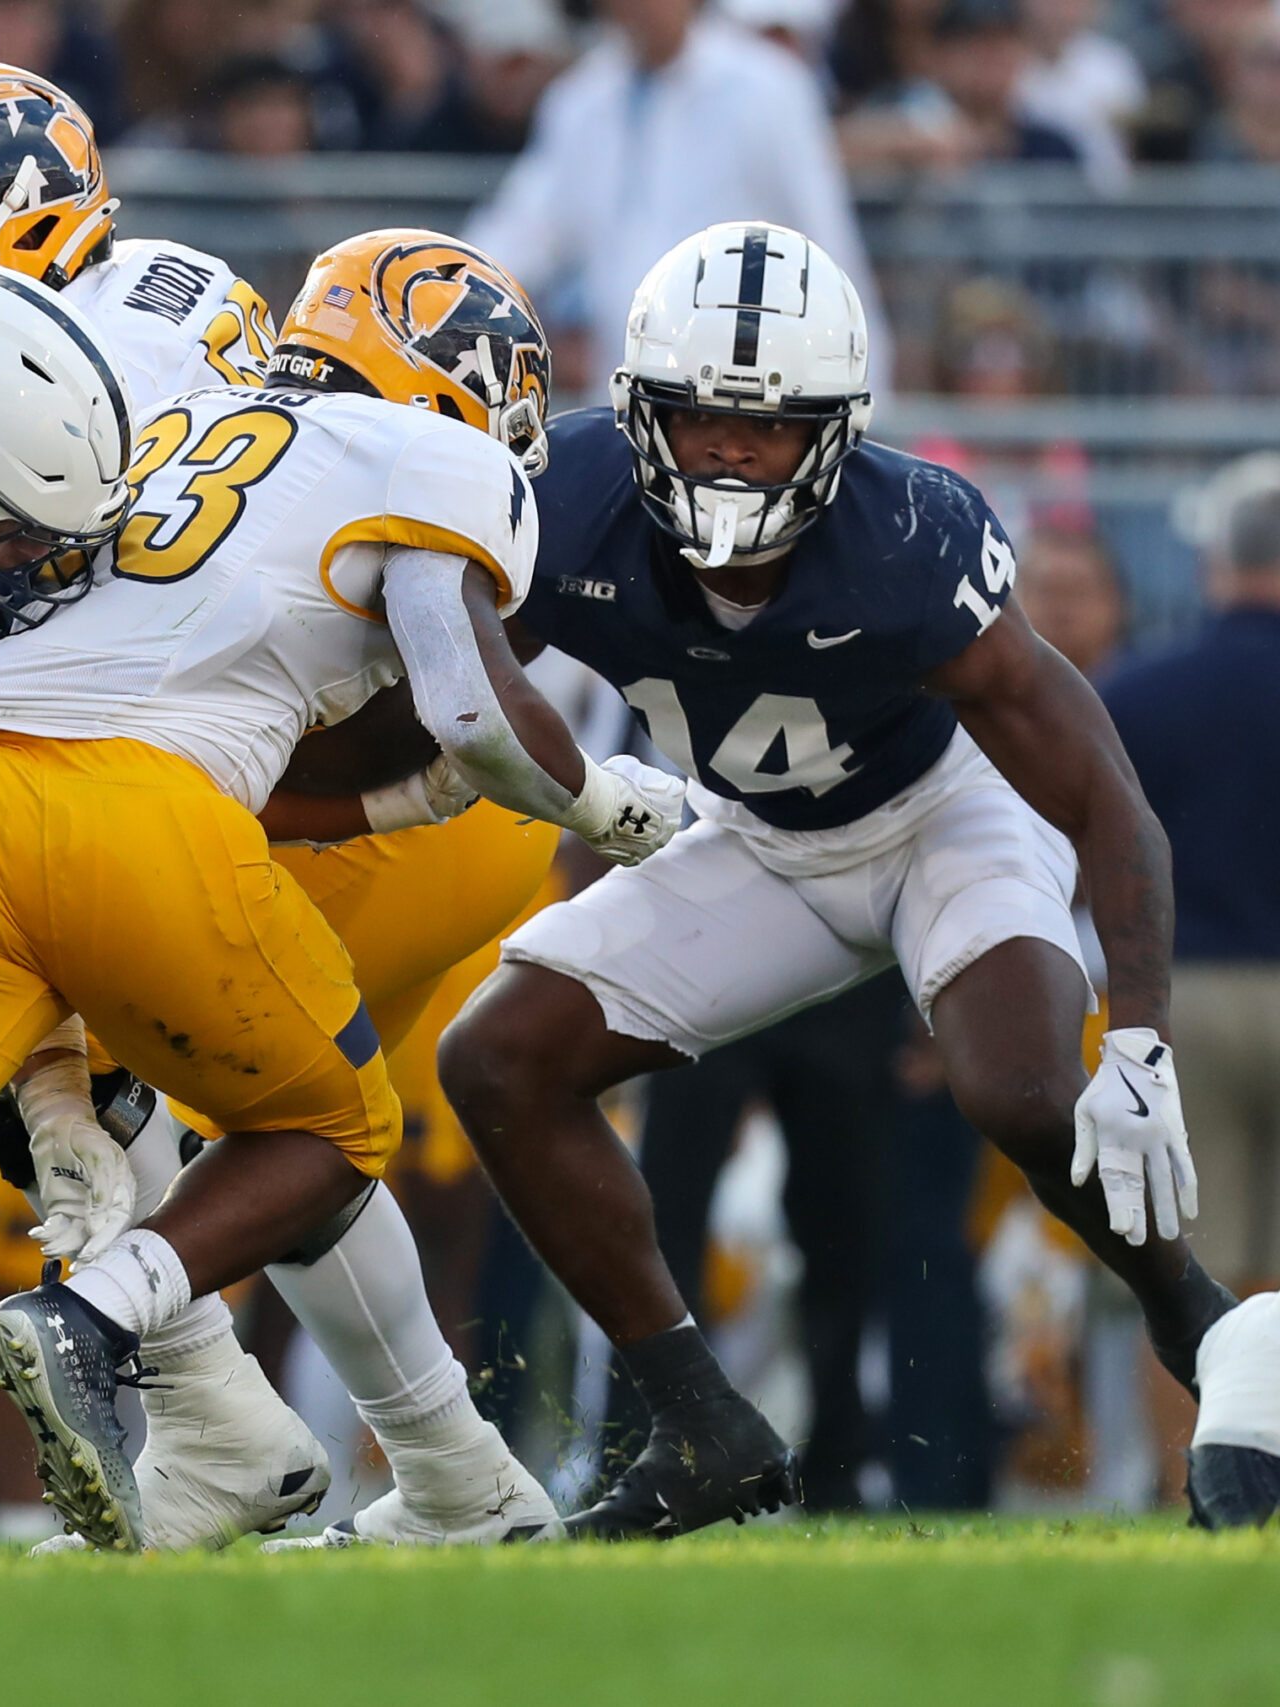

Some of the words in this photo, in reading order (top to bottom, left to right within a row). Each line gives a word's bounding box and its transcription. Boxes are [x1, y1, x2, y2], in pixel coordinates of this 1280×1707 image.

[122, 253, 216, 326] MADDOX
[952, 519, 1017, 637] 14
[621, 676, 865, 799] 14
